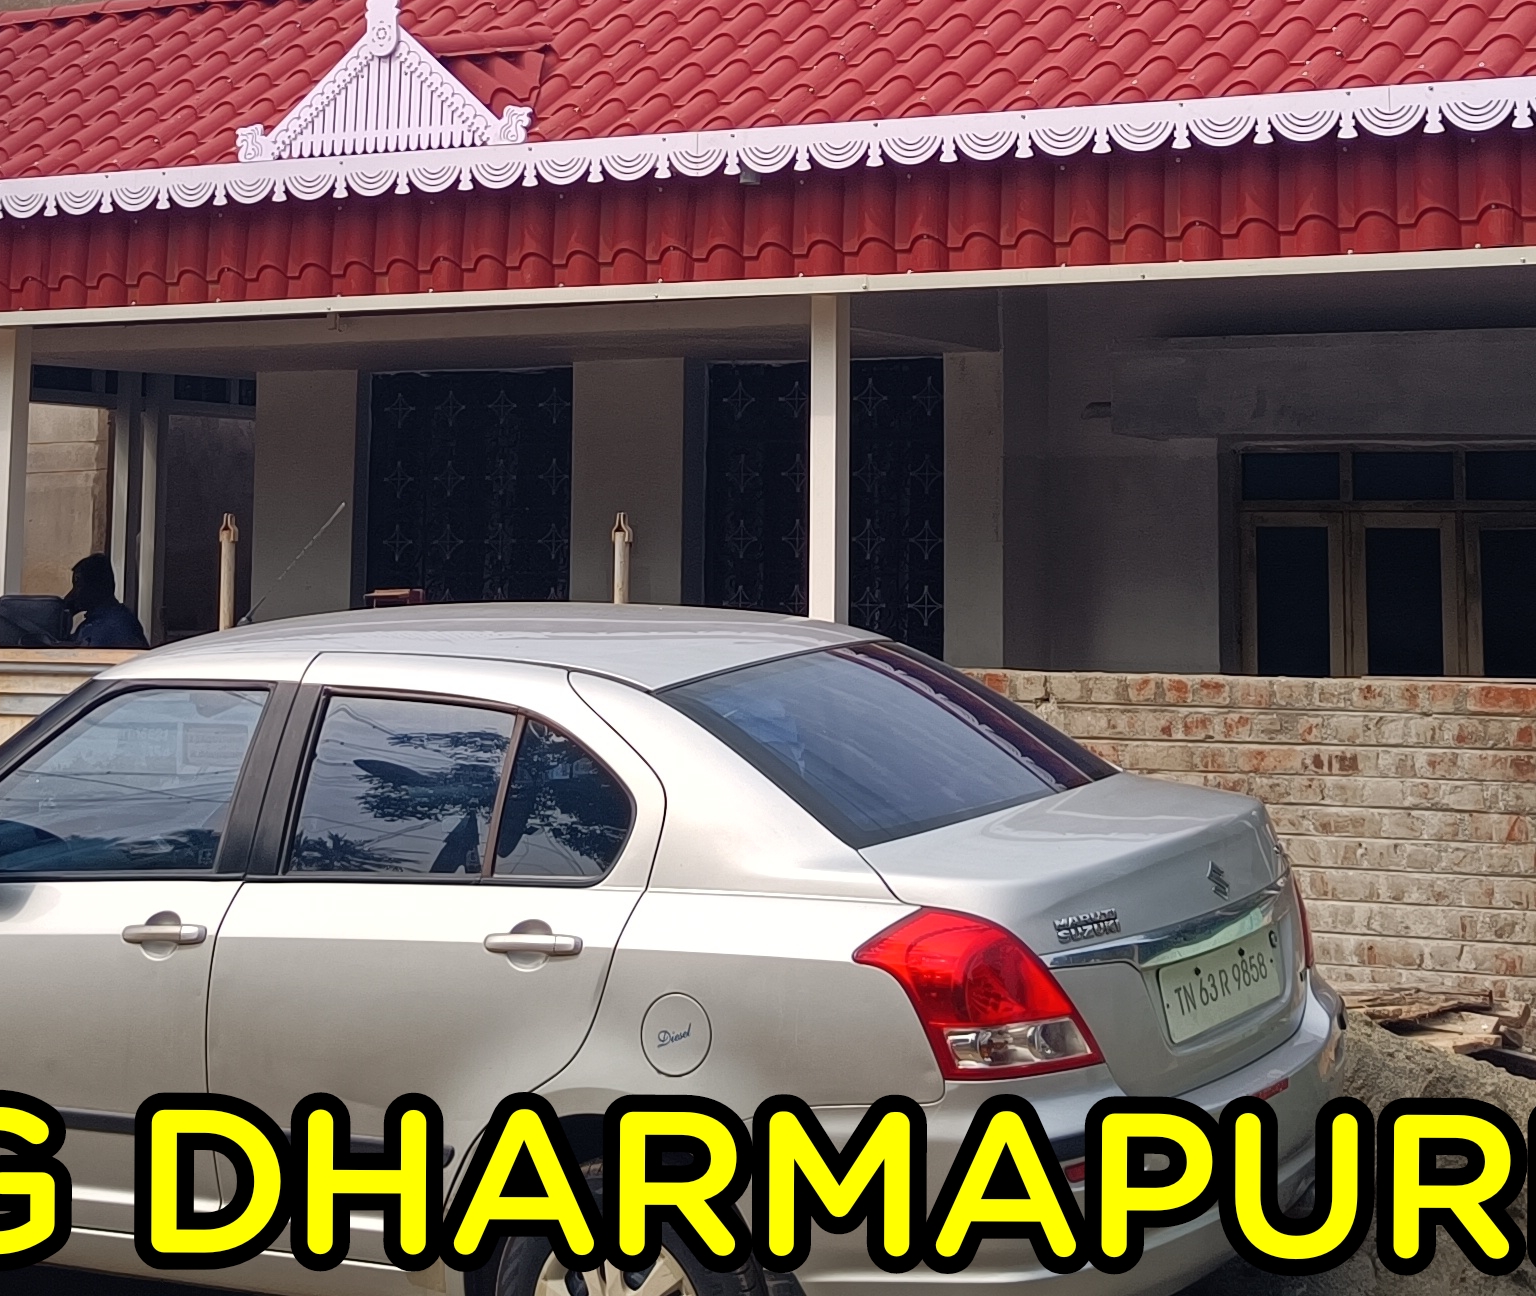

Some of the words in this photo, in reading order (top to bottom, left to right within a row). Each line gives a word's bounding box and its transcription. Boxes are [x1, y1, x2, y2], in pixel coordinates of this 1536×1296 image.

[1053, 907, 1118, 930] MARUTI
[1057, 918, 1122, 945] SUZUKI
[1174, 981, 1197, 1016] TN
[1199, 973, 1219, 1007] 63
[1231, 951, 1268, 991] 9858
[657, 1022, 692, 1049] Diesel
